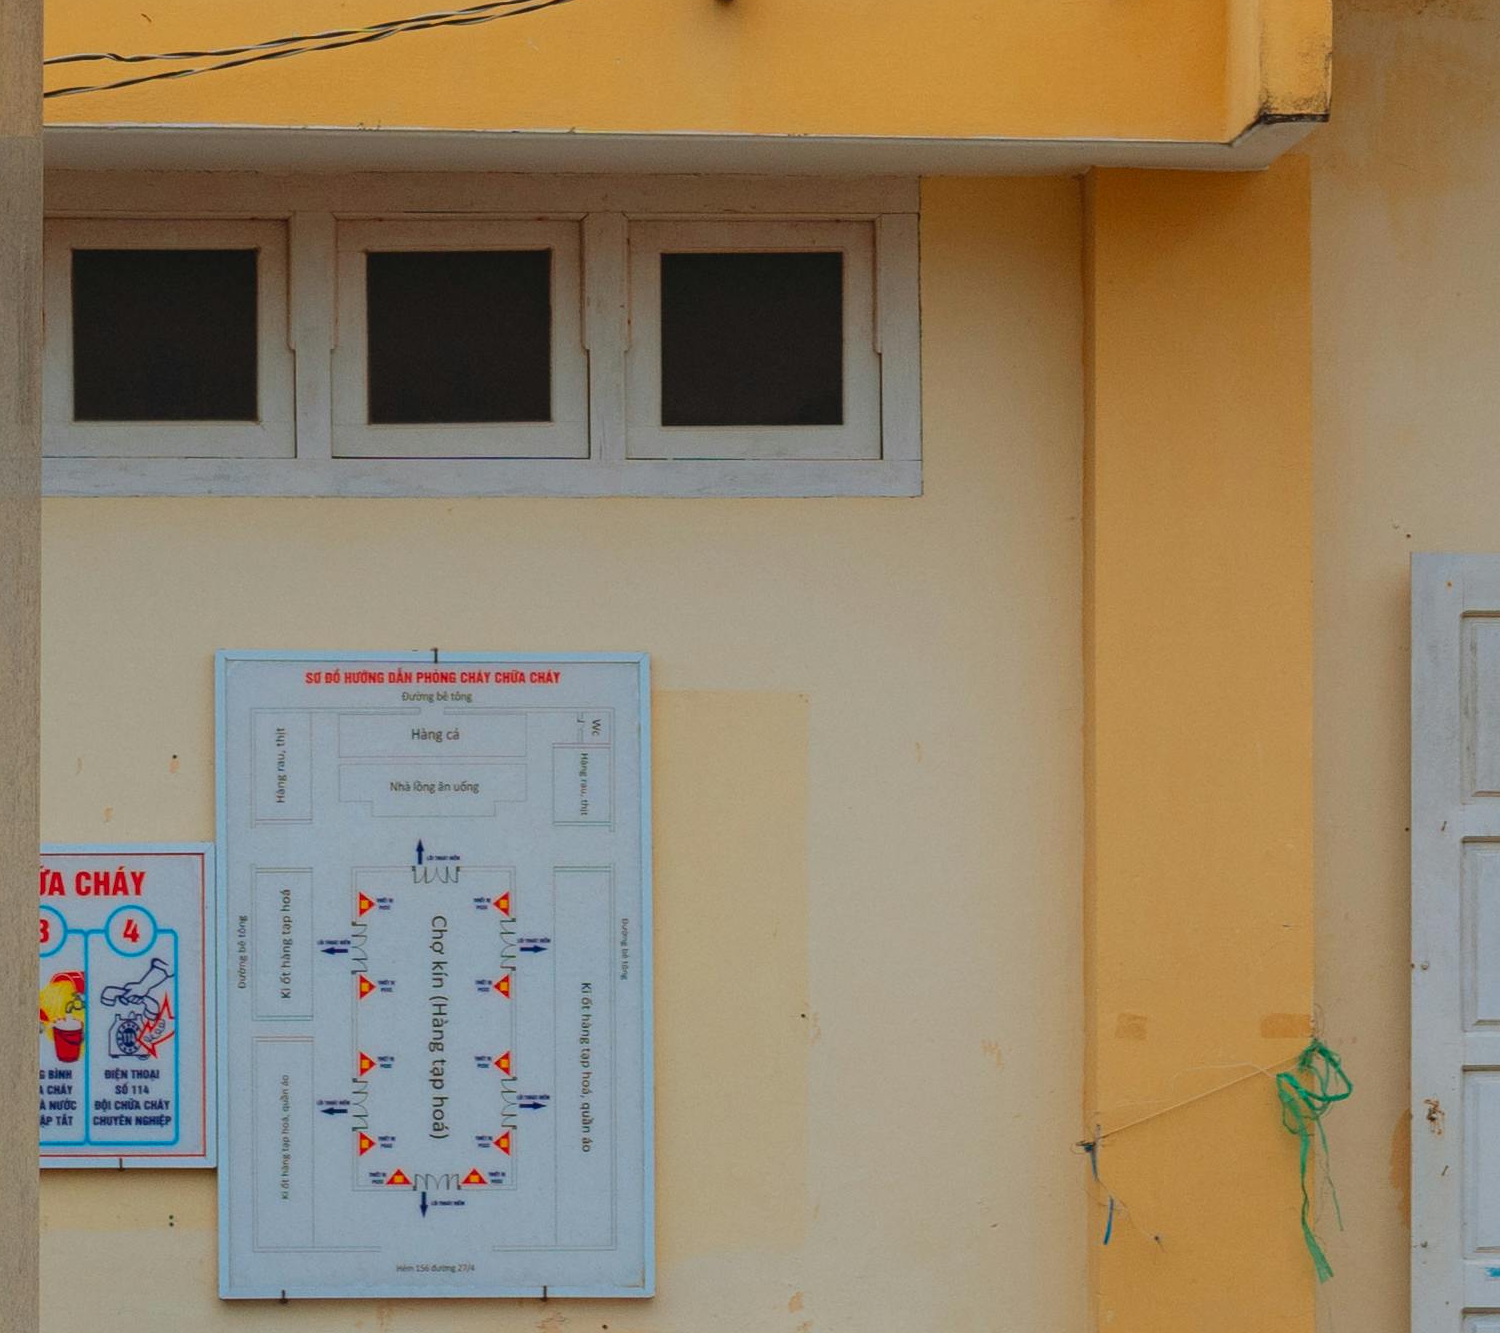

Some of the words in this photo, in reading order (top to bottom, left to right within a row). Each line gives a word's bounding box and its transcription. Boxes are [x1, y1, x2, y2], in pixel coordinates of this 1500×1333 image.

[411, 728, 443, 743] Hàng
[75, 866, 147, 897] CHÁY
[123, 919, 140, 943] 4
[430, 915, 448, 954] Chợ
[432, 961, 448, 988] kín
[429, 995, 449, 1052] (Hàng
[104, 1068, 128, 1081] ĐIỆN
[429, 1059, 448, 1090] tạp
[132, 1085, 149, 1094] 114
[429, 1096, 449, 1139] hoá)
